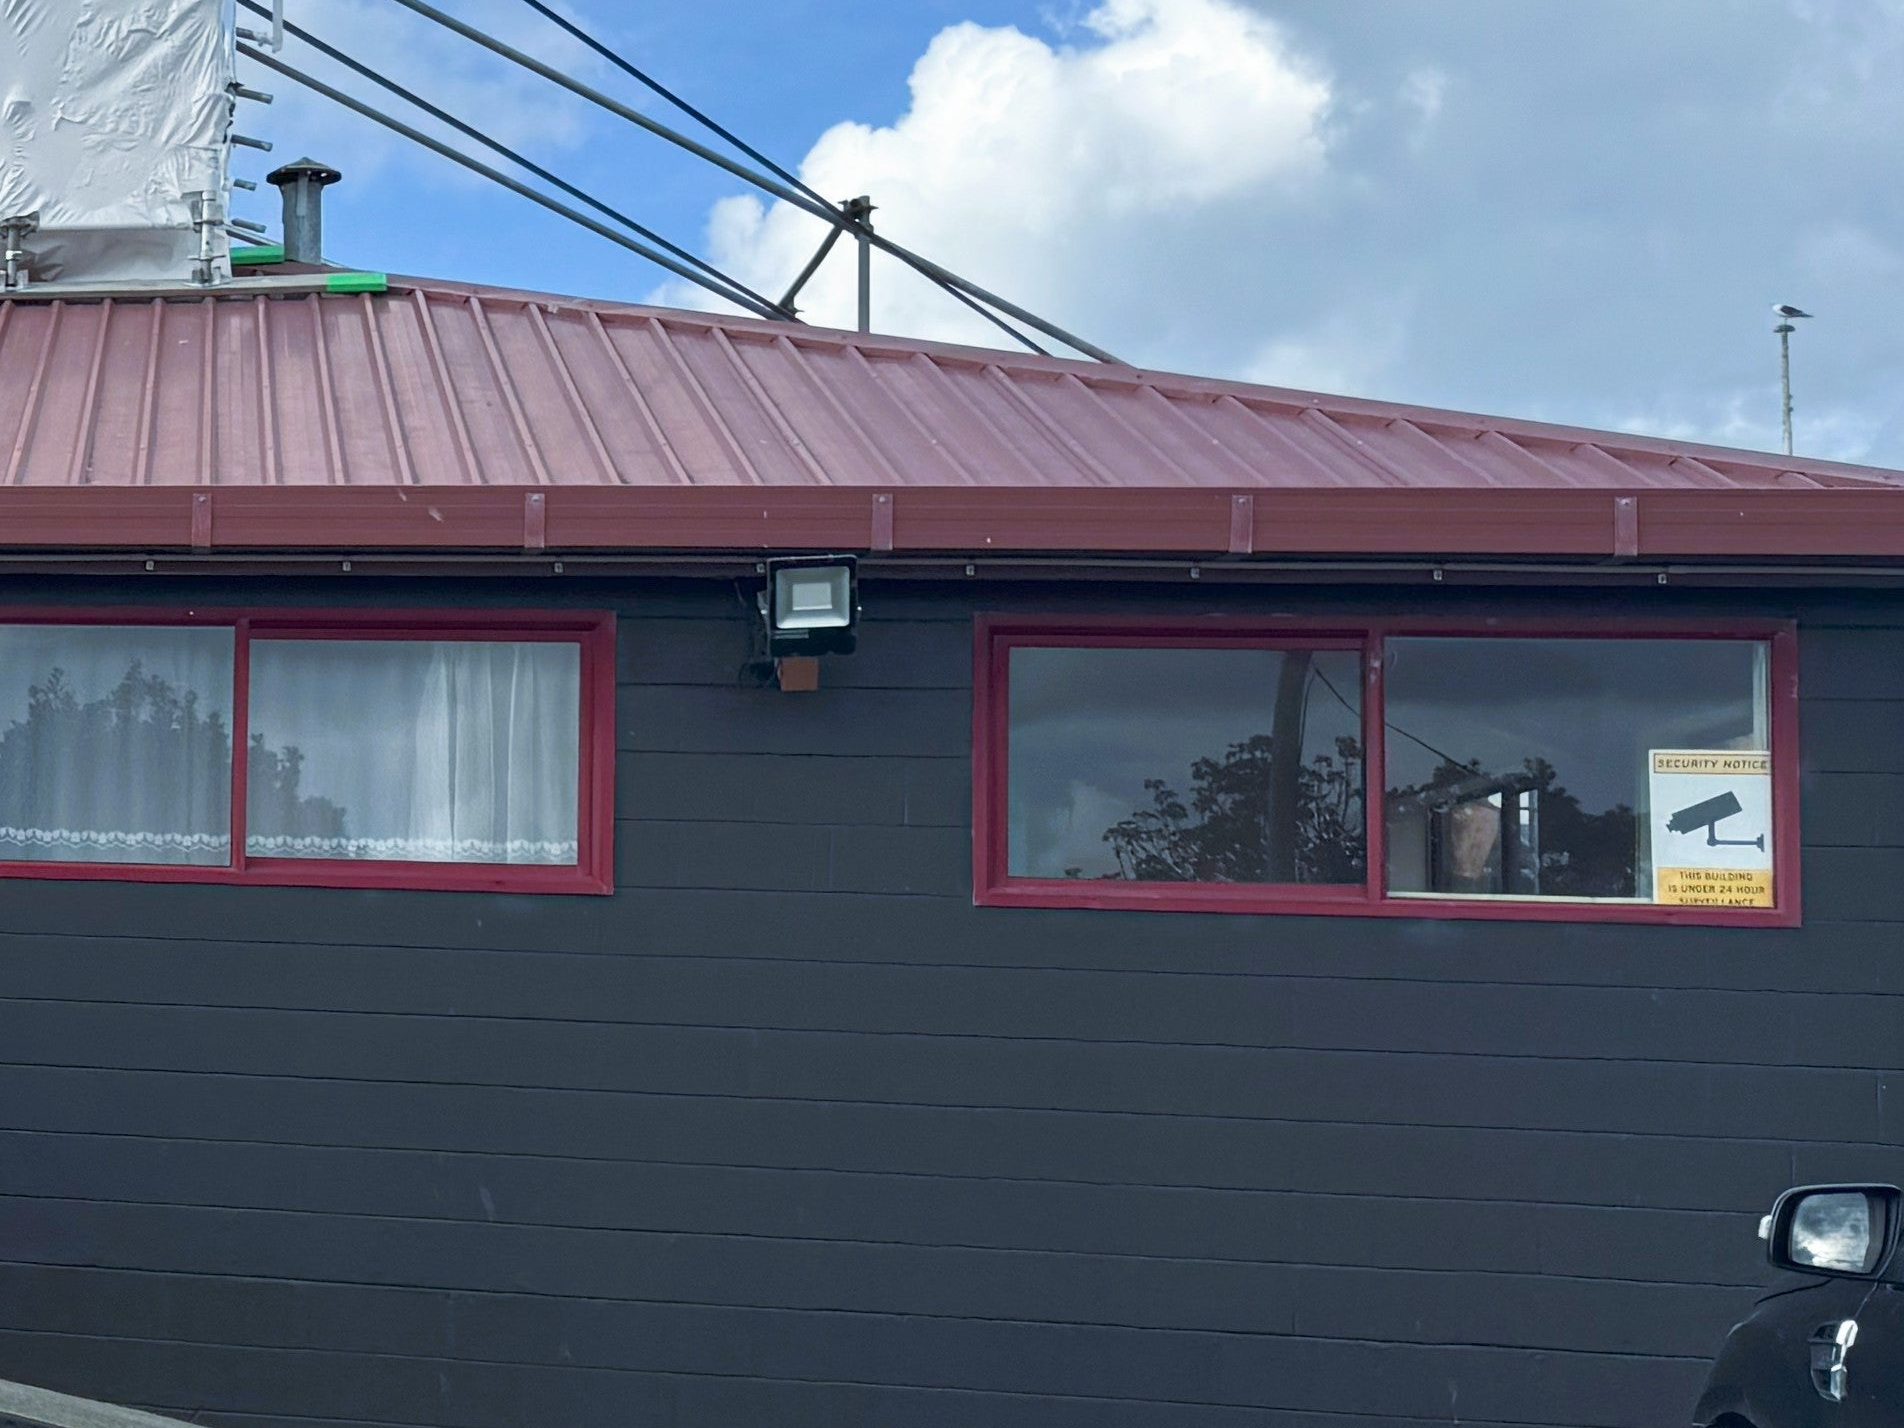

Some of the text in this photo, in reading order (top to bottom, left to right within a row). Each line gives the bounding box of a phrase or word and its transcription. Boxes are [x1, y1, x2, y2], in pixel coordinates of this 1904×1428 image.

[1657, 758, 1769, 770] SECURITY NOTICE
[1679, 871, 1754, 882] THIS BUILDING
[1668, 884, 1766, 895] IS UNDER 24 HOUR
